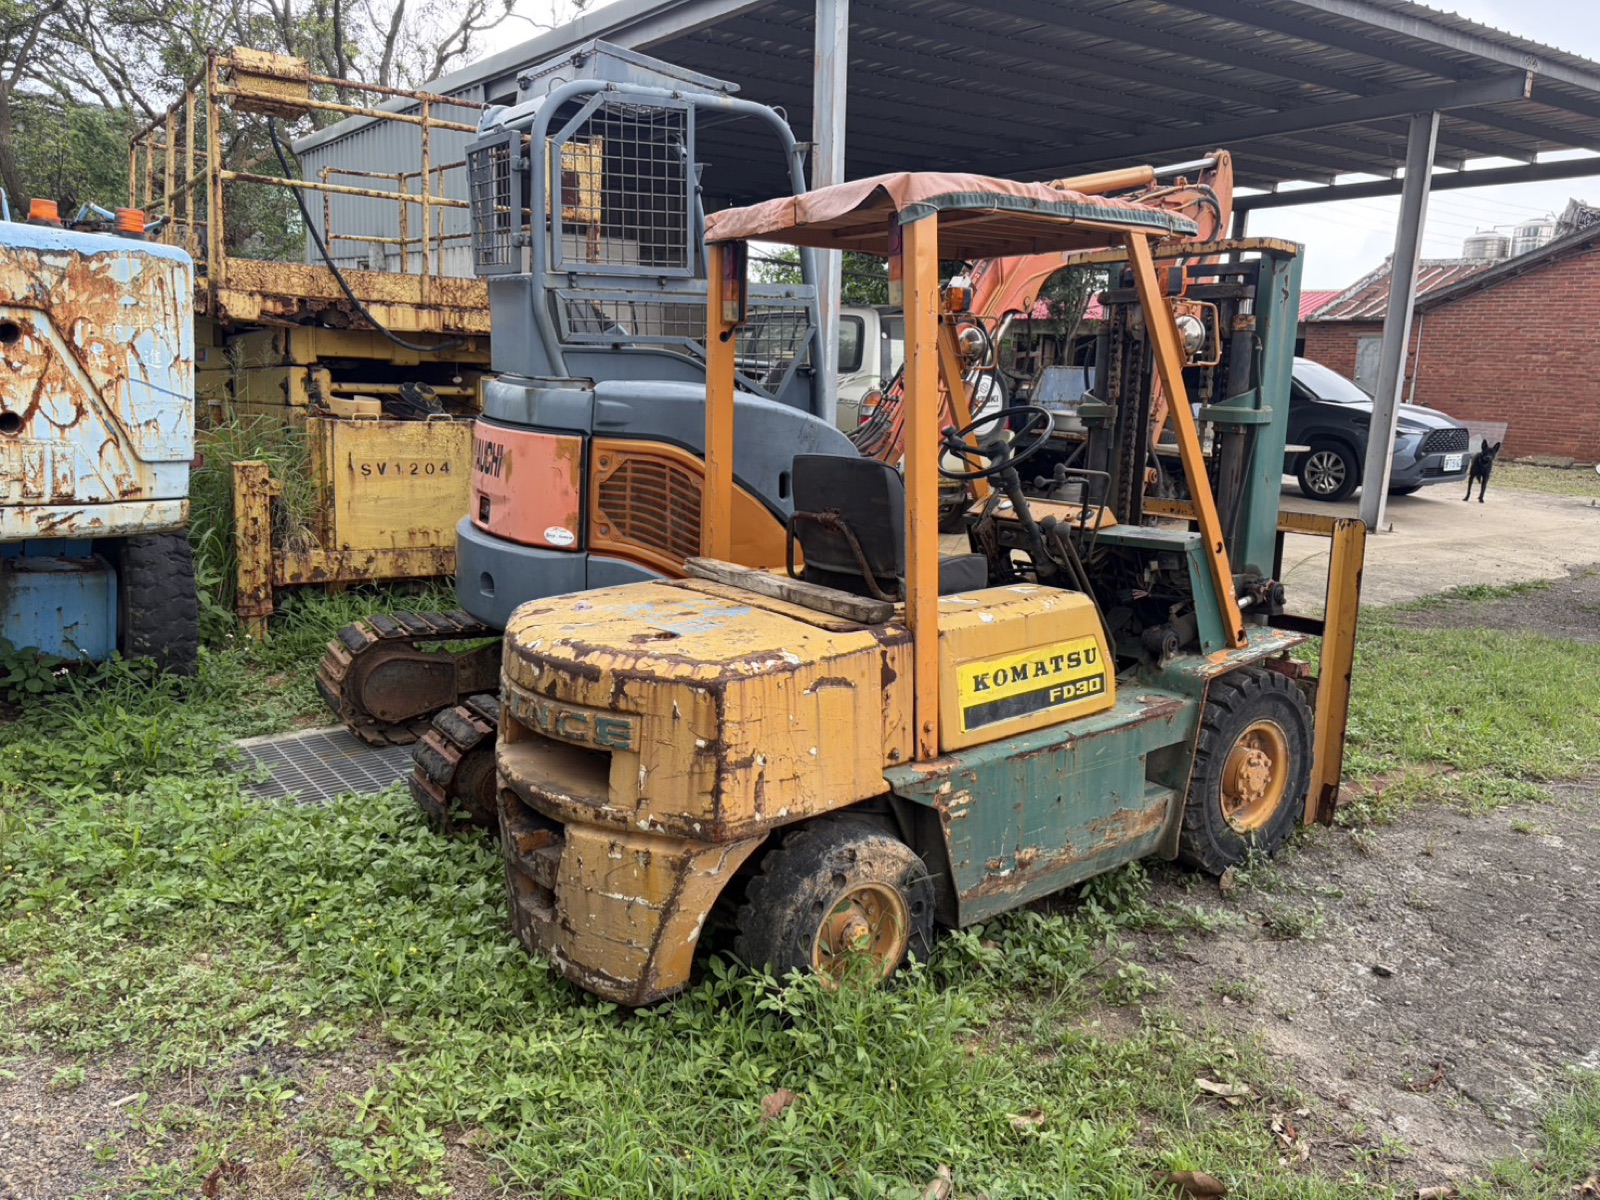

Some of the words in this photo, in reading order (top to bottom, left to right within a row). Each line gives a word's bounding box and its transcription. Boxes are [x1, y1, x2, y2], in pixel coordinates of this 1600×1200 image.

[361, 461, 450, 476] SV1204
[972, 647, 1097, 692] KOMATSU
[1050, 677, 1102, 703] FD30
